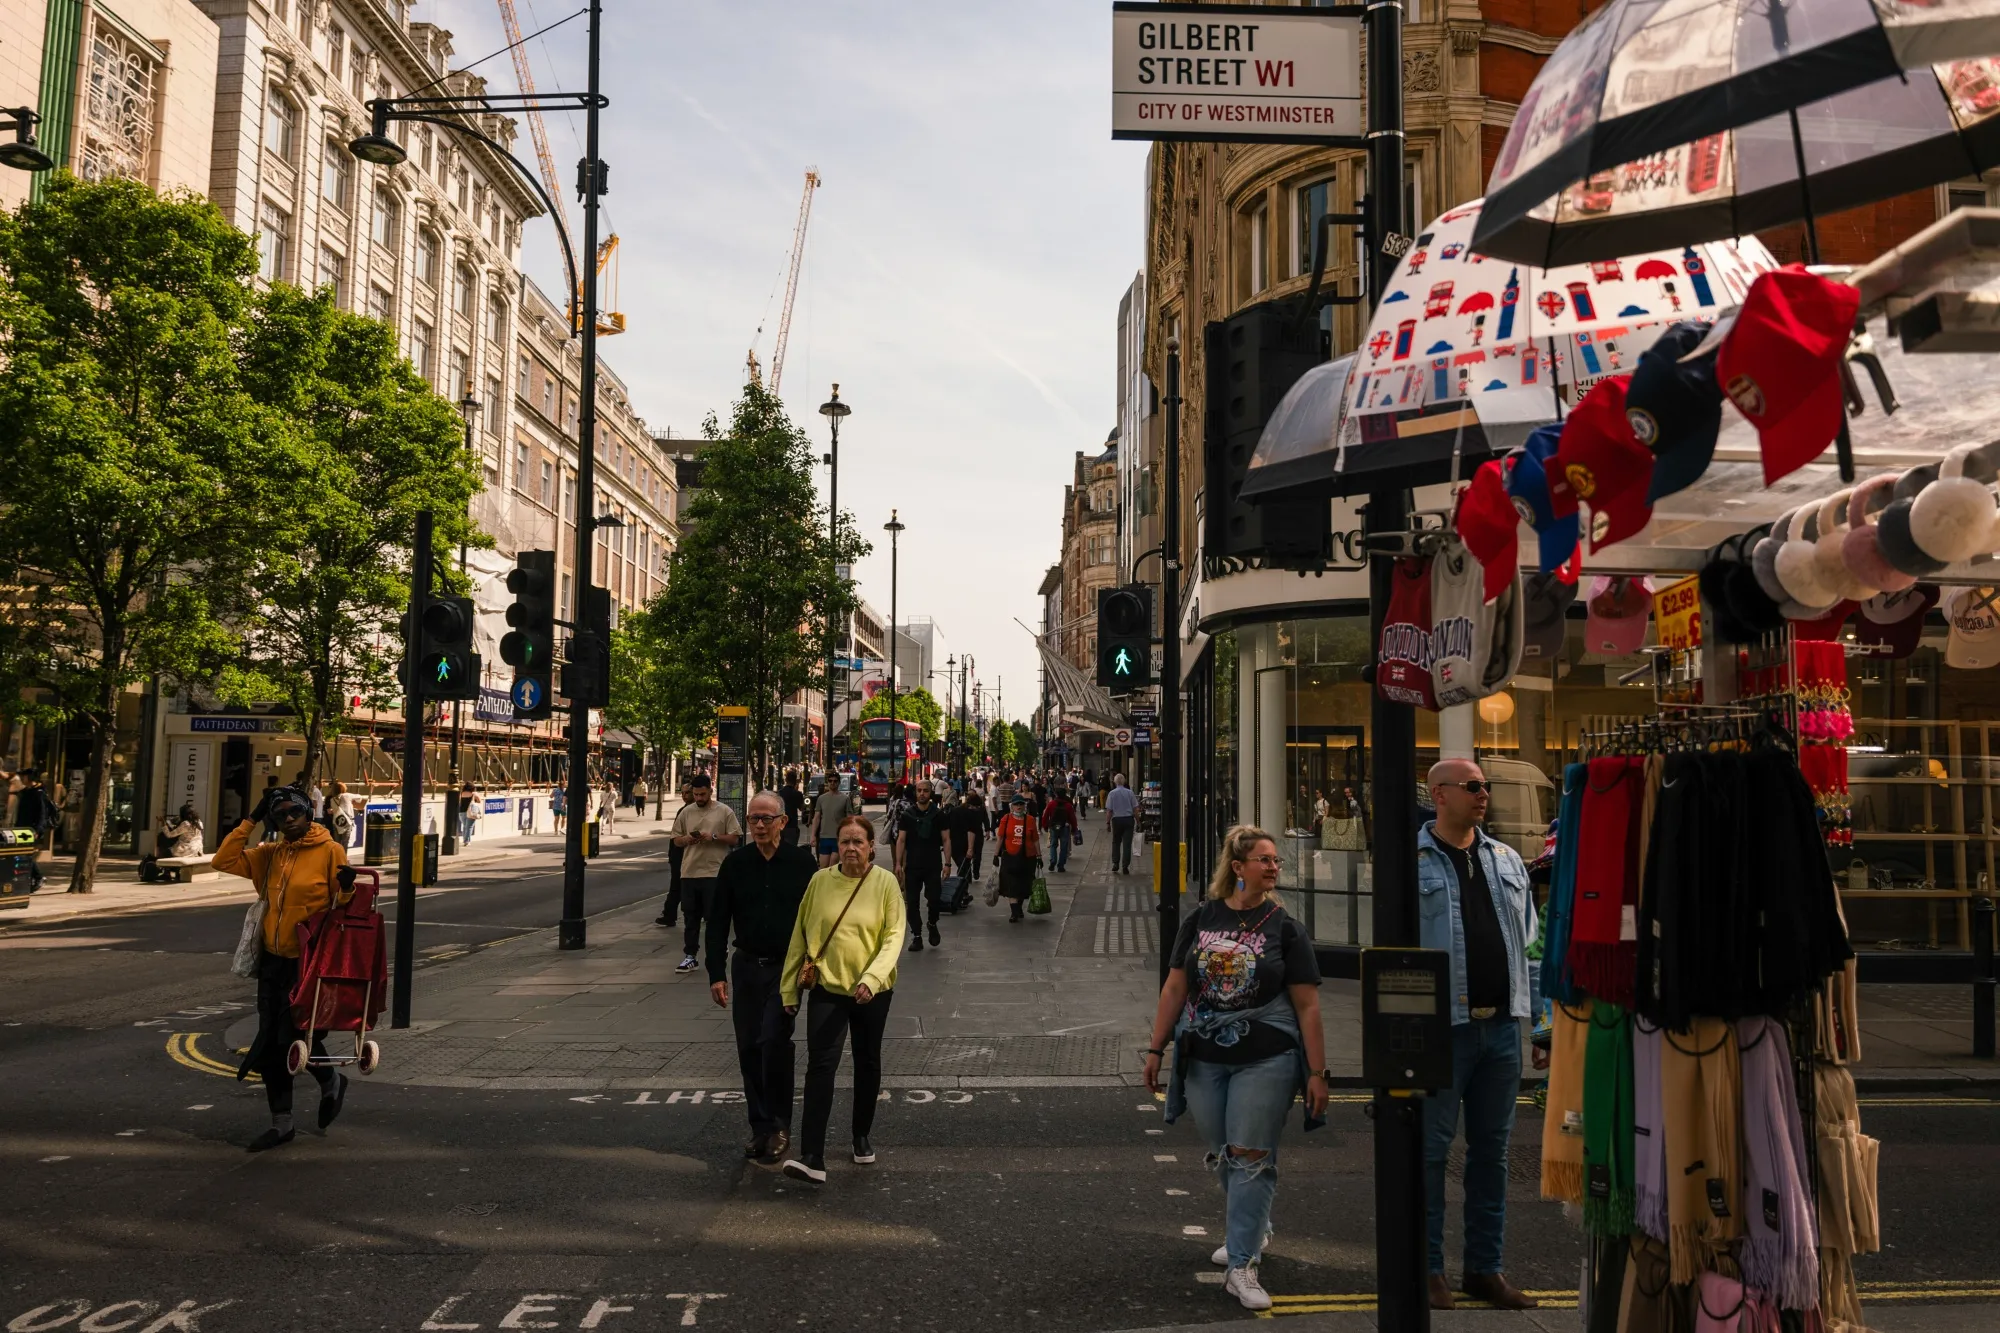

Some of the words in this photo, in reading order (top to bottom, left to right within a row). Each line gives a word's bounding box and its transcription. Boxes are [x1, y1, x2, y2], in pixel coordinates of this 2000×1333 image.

[1138, 22, 1259, 52] GILBERT
[1138, 57, 1247, 86] STREET
[1255, 60, 1295, 87] W1
[1138, 102, 1177, 120] CITY
[1182, 103, 1203, 121] OF
[1207, 104, 1335, 124] WESTMINSTER
[1384, 233, 1410, 257] S138
[1661, 587, 1694, 617] £2.99
[1379, 623, 1432, 673] ONDON
[194, 720, 256, 730] FAITHDEAN
[419, 1291, 729, 1330] LEFT
